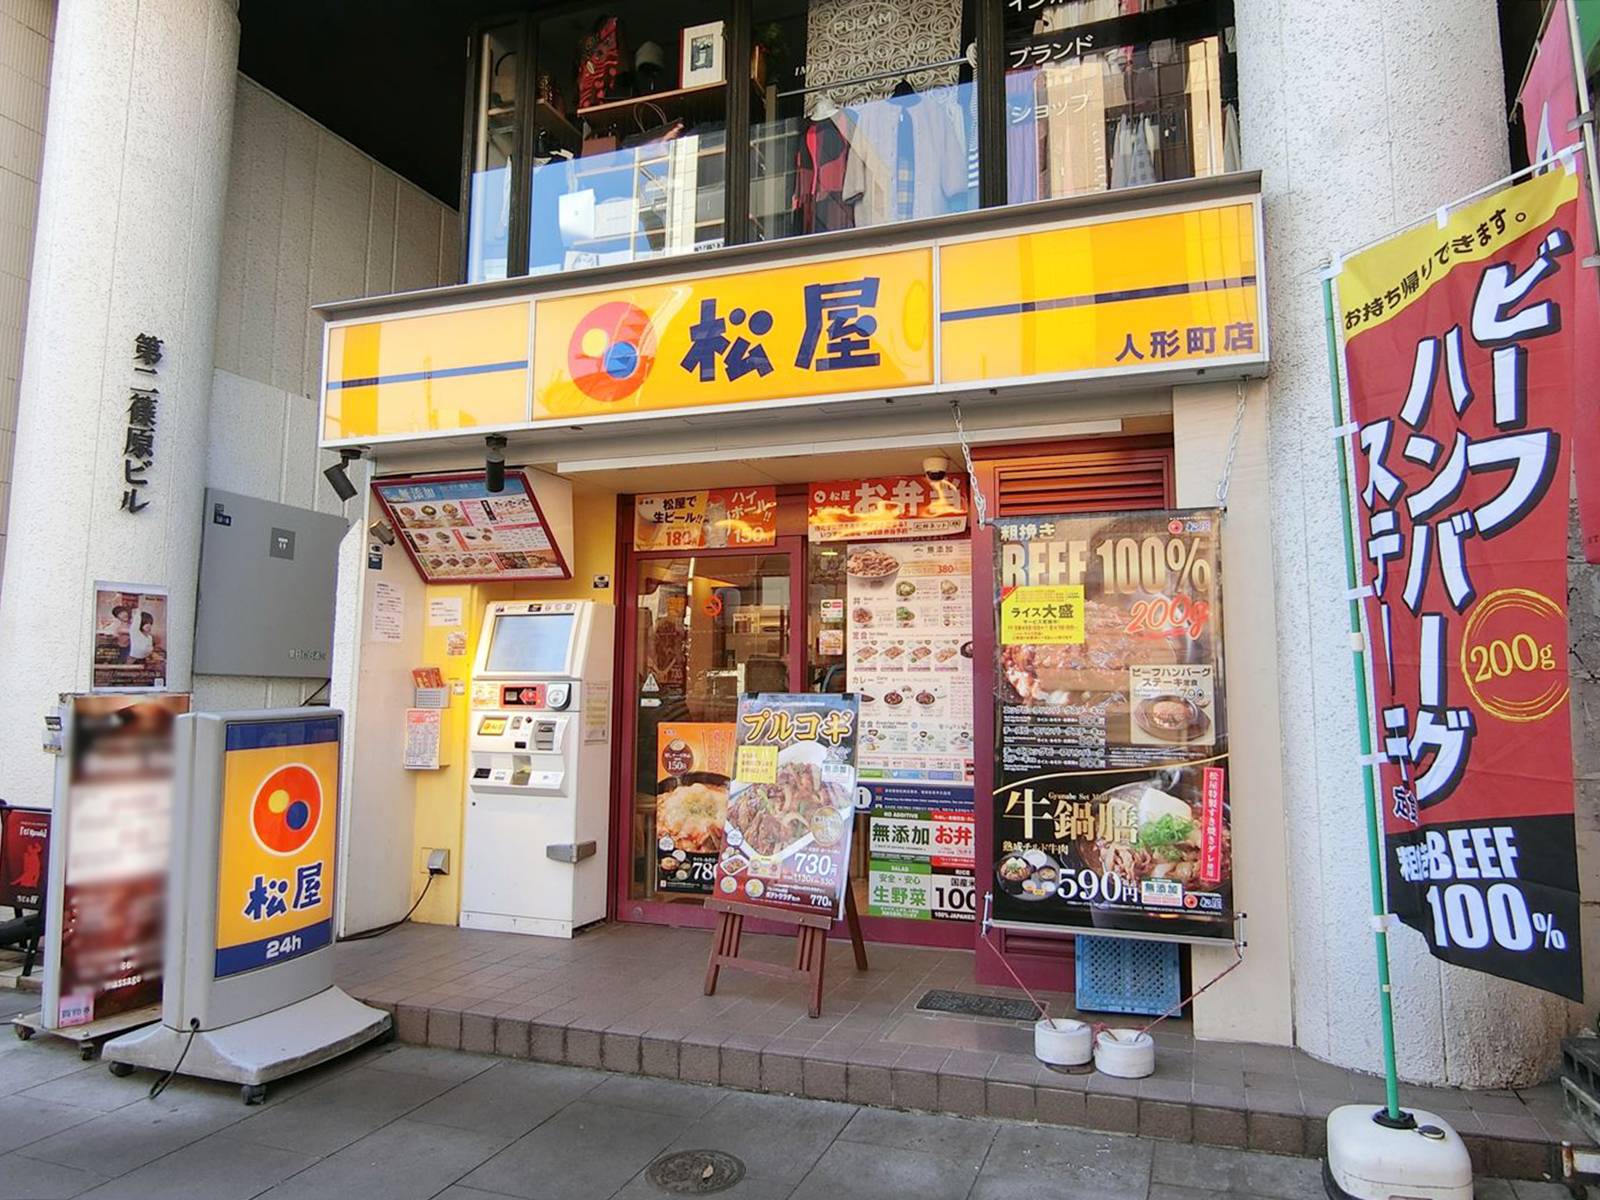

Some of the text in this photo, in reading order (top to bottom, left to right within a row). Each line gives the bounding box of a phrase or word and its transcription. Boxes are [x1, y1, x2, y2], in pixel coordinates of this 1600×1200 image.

[1009, 34, 1093, 68] ブランド
[1011, 90, 1093, 124] ショップ
[1344, 208, 1527, 330] お持ち帰りできます。
[680, 277, 881, 383] 松屋
[1115, 321, 1254, 362] 人形町店
[662, 495, 698, 511] 松屋で
[731, 490, 758, 503] ハイ
[1000, 523, 1056, 541] 粗挽き
[1002, 537, 1211, 595] BEEF 100%
[1010, 603, 1074, 618] ライス大盛
[1126, 593, 1211, 641] 200g
[1132, 667, 1211, 677] ビーフハンバーグ
[1469, 632, 1556, 684] 200g
[742, 708, 853, 745] プルコギ
[1002, 787, 1140, 844] 牛鍋膳
[872, 823, 930, 846] 無添加
[934, 825, 973, 846] お弁
[1426, 826, 1519, 881] BEEF
[242, 861, 323, 921] 松屋
[873, 885, 926, 906] 生野菜
[879, 873, 921, 885] 安全・安心
[1144, 882, 1179, 895] 無添加
[1426, 883, 1567, 952] 100%
[266, 934, 302, 960] 24h
